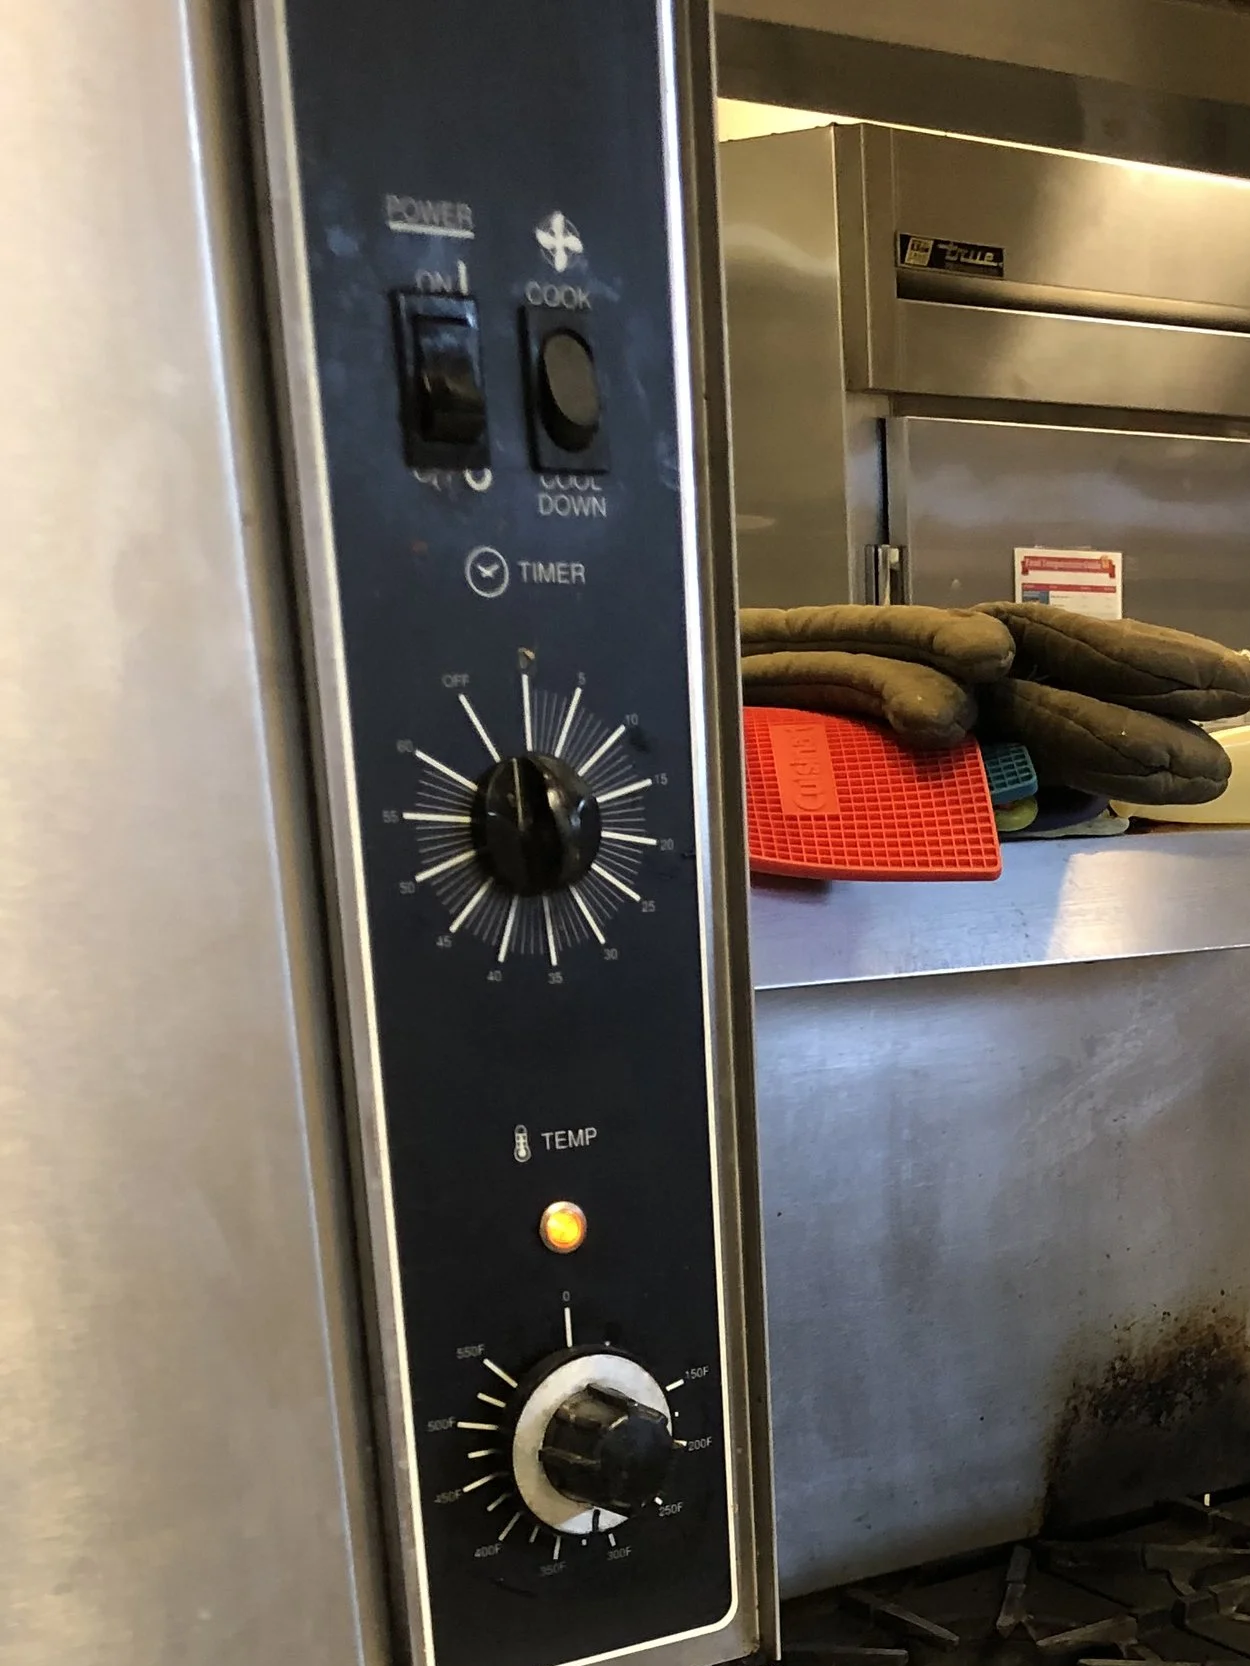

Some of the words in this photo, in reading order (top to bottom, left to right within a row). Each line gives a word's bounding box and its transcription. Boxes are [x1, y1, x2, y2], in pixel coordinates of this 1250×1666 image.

[386, 193, 474, 230] POWER
[415, 269, 452, 292] ON
[525, 280, 592, 311] COOK
[538, 493, 607, 518] DOWN
[517, 561, 586, 585] TIMER
[442, 674, 469, 688] OFF
[625, 714, 639, 726] 10
[655, 774, 668, 785] 15
[382, 811, 398, 823] 55
[660, 839, 674, 851] 20
[641, 901, 655, 913] 25
[436, 936, 452, 948] 45
[604, 949, 618, 961] 30
[487, 970, 502, 982] 40
[548, 972, 563, 984] 35
[541, 1127, 598, 1151] TEMP
[456, 1345, 485, 1360] 550F
[684, 1365, 709, 1380] 150F
[427, 1418, 456, 1433] 500F
[687, 1437, 713, 1451] 200F
[658, 1503, 683, 1517] 250F
[474, 1544, 501, 1559] 400F
[606, 1547, 632, 1562] 300F
[538, 1561, 567, 1578] 350F
